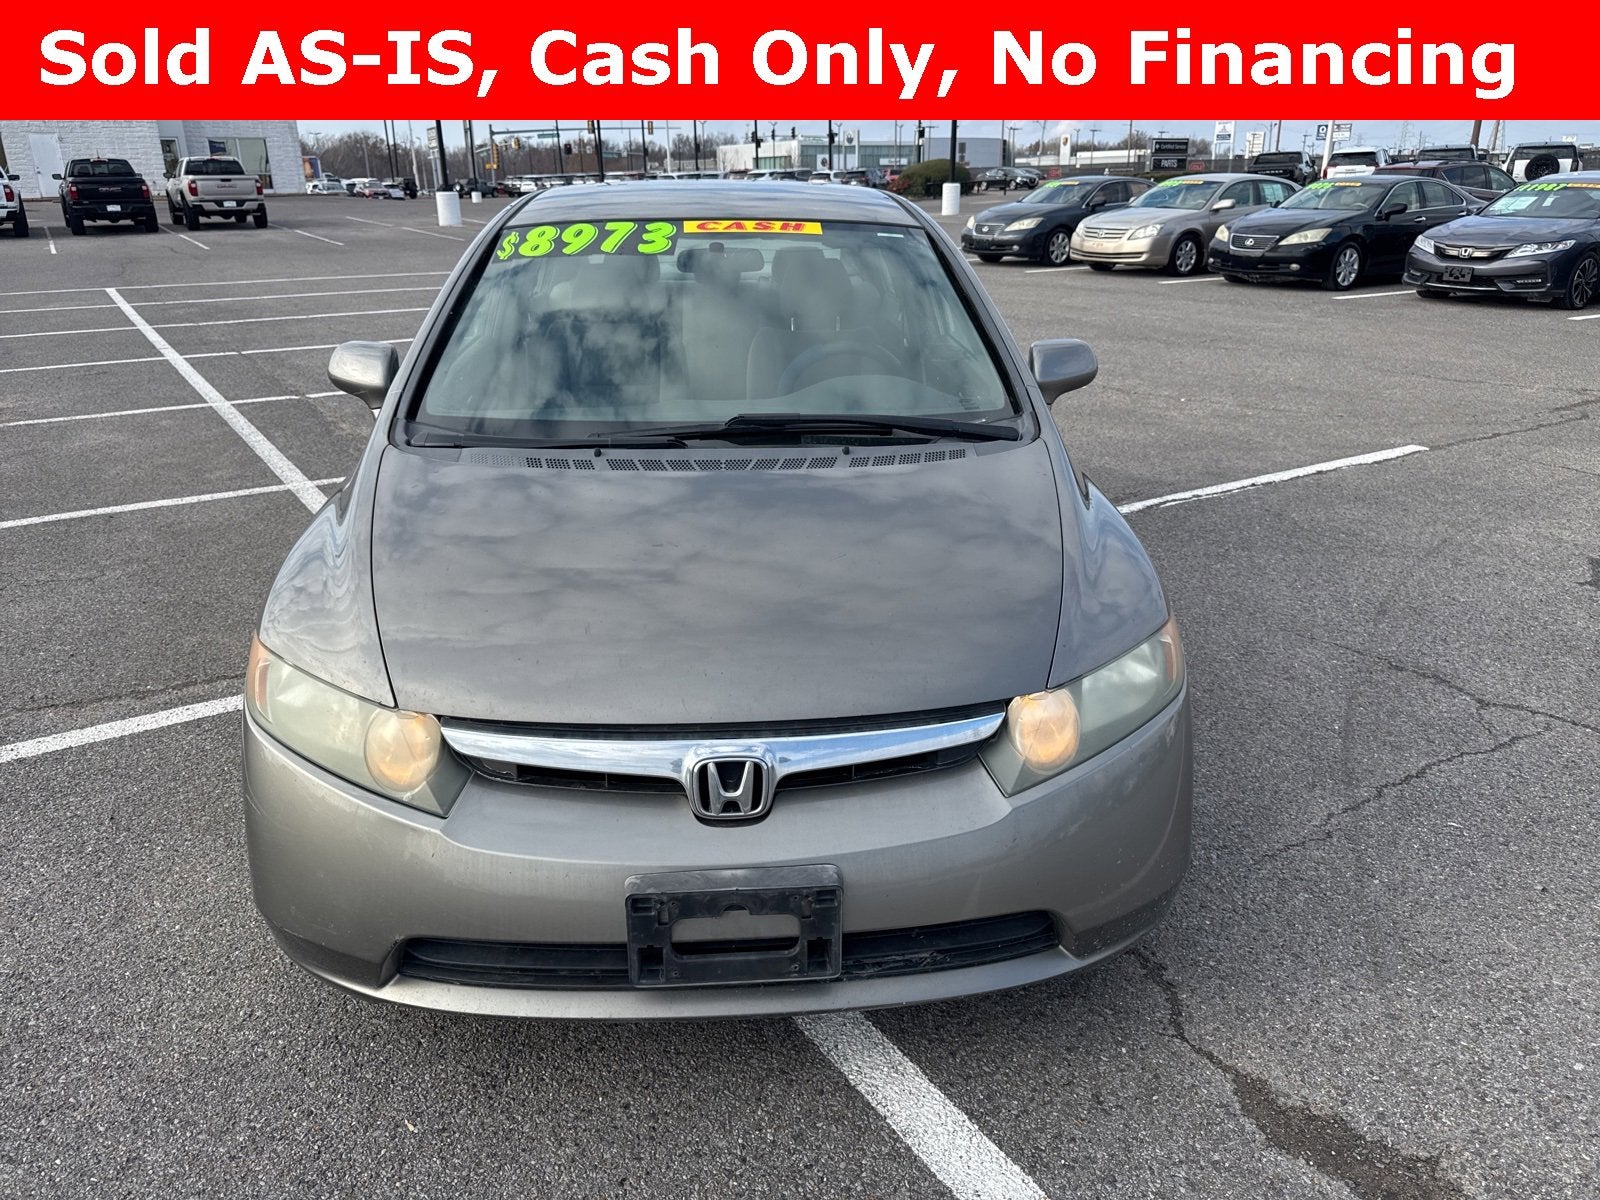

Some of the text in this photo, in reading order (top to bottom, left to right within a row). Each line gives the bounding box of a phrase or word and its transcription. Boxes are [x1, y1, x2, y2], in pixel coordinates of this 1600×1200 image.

[1161, 159, 1178, 168] PARTS
[497, 220, 807, 260] $8973 CASH
